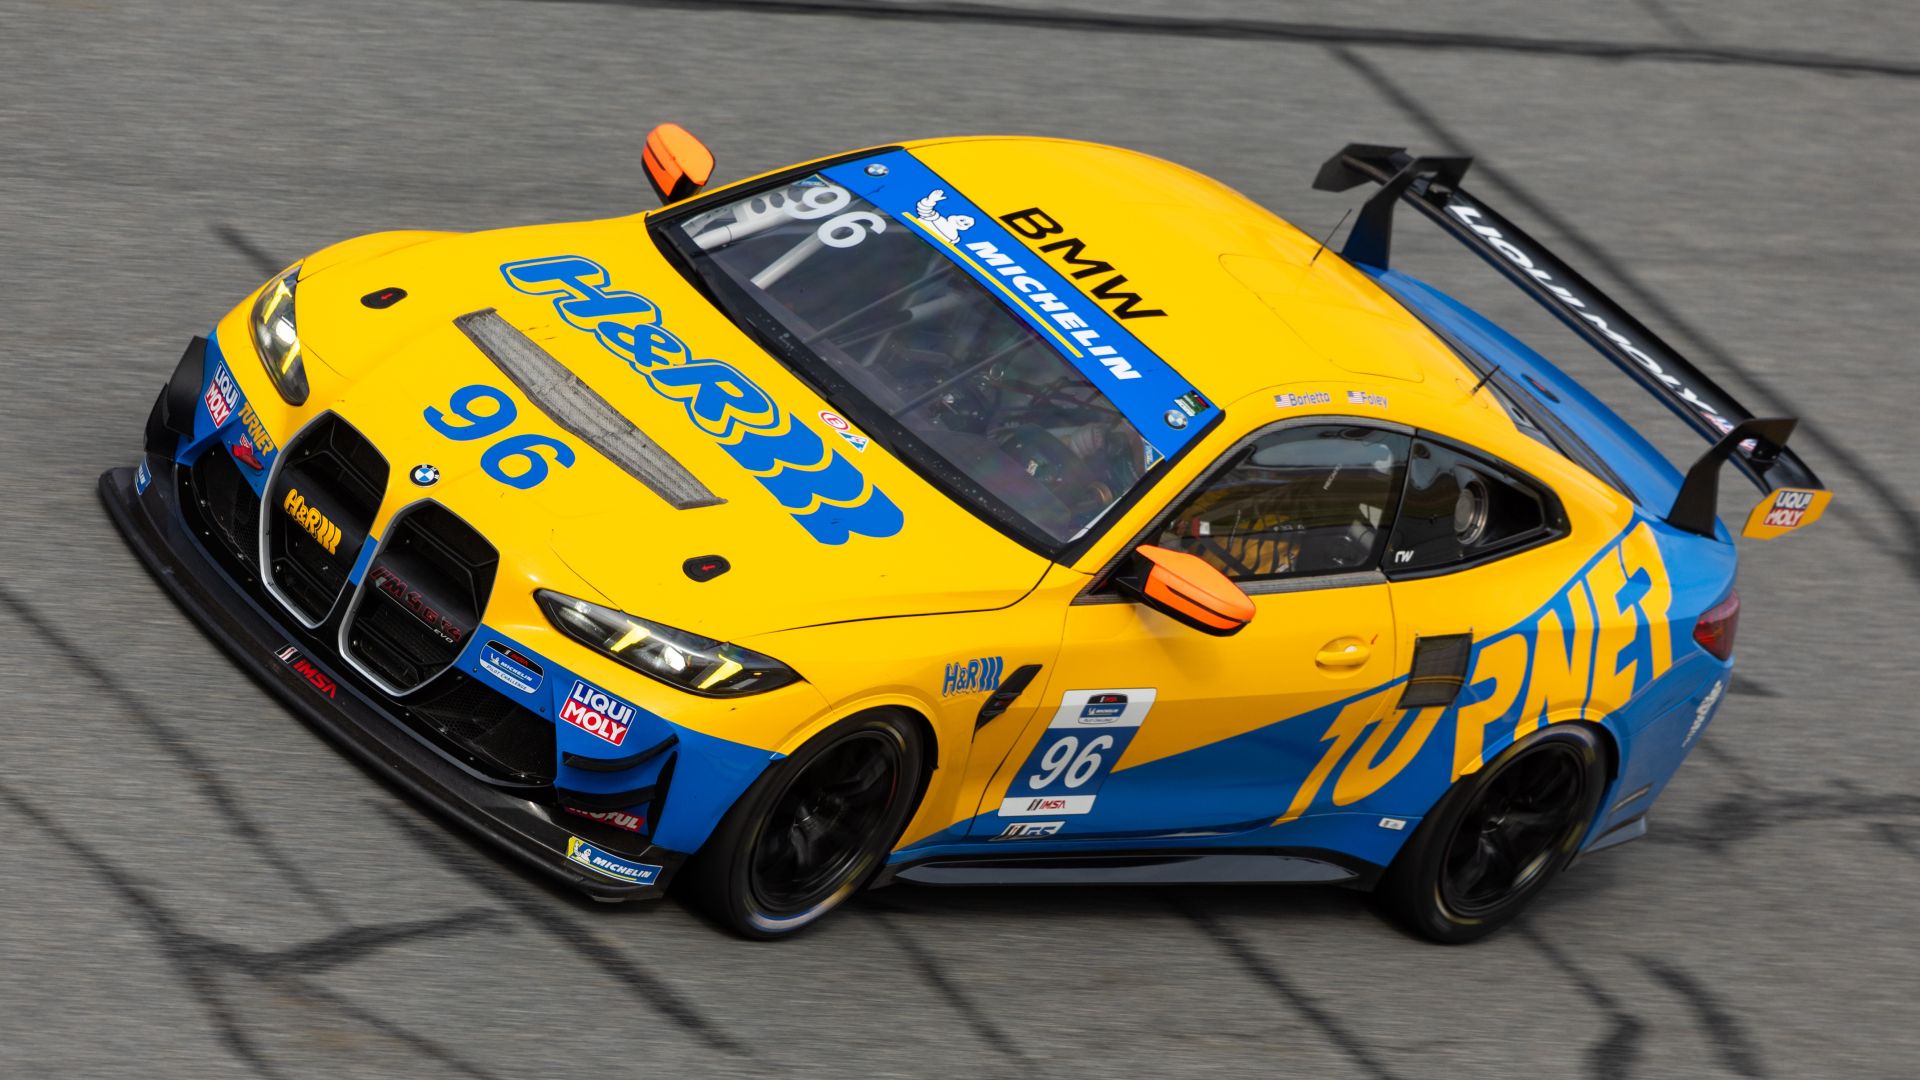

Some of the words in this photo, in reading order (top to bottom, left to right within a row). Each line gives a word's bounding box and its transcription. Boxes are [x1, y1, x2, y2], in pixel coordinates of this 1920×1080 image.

[783, 186, 886, 249] 96
[999, 207, 1168, 320] BMW
[965, 241, 1142, 381] MICHELIN
[1449, 204, 1586, 309] LIQUI
[1578, 311, 1719, 415] MOLY
[205, 382, 230, 425] MOLY
[214, 364, 239, 409] LIQUI
[1360, 391, 1387, 408] Foley
[238, 401, 274, 457] TURNER
[423, 384, 576, 490] 96
[1764, 509, 1804, 526] MOLY
[1776, 491, 1813, 508] LIQUI
[433, 628, 454, 643] EVO
[293, 658, 336, 699] IMSA
[500, 661, 533, 682] MICHELIN
[1271, 520, 1672, 828] TURNER
[563, 700, 627, 741] MOLY
[573, 683, 633, 724] LIQUI
[1029, 735, 1113, 790] 96
[568, 808, 639, 829] TUL
[1039, 800, 1065, 809] IMSA
[593, 856, 652, 878] MICHELIN
